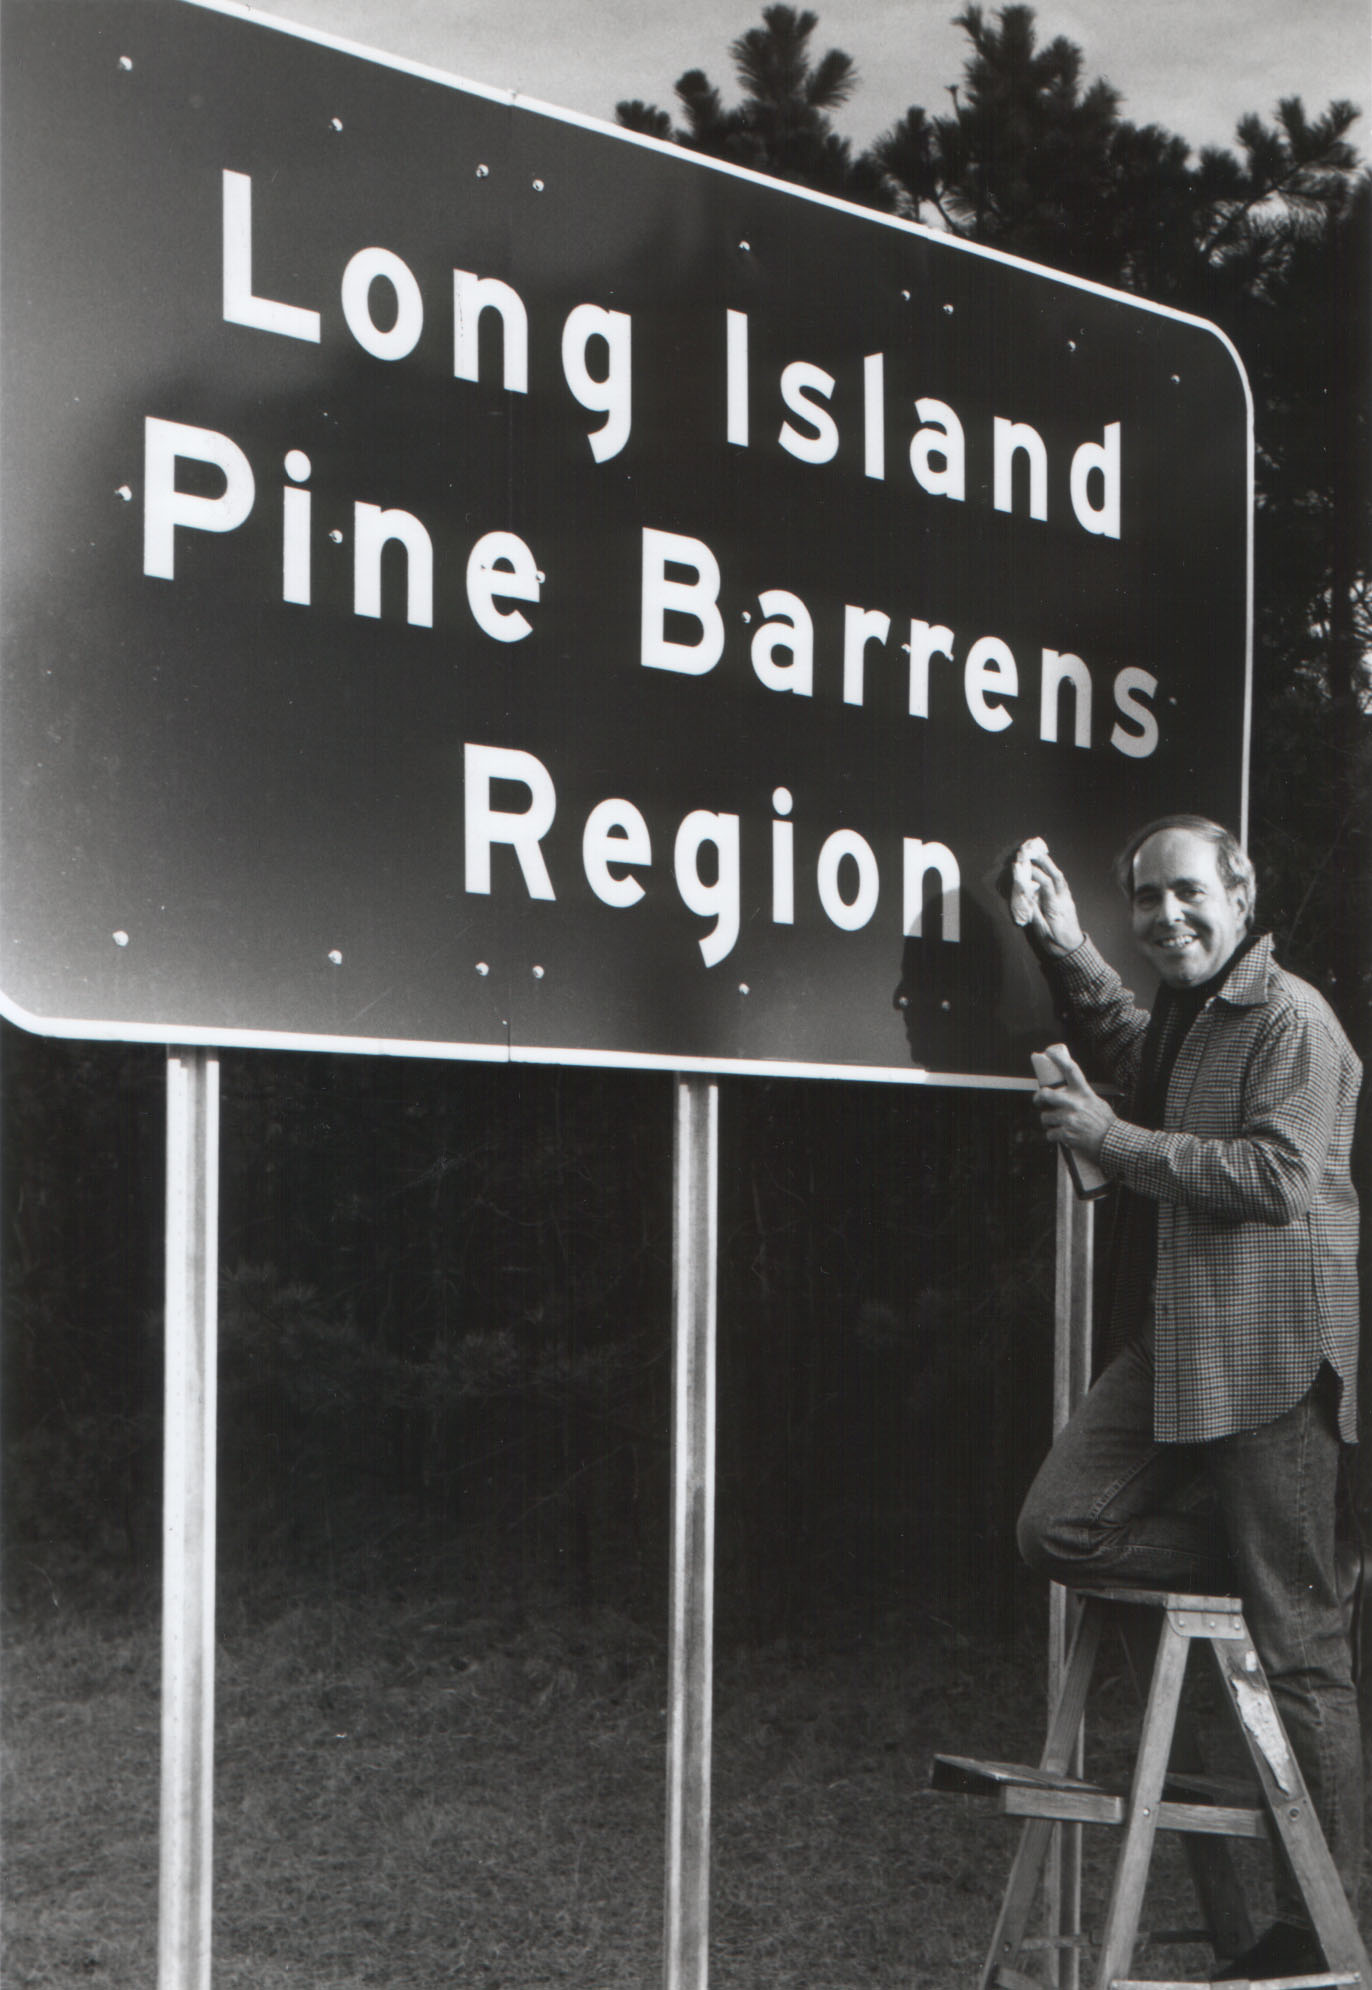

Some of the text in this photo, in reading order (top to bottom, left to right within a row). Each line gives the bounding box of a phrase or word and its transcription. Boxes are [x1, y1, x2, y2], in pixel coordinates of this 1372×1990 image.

[222, 168, 1123, 540] Long Island
[143, 416, 1160, 759] Pine Barrens
[464, 742, 962, 969] Region
